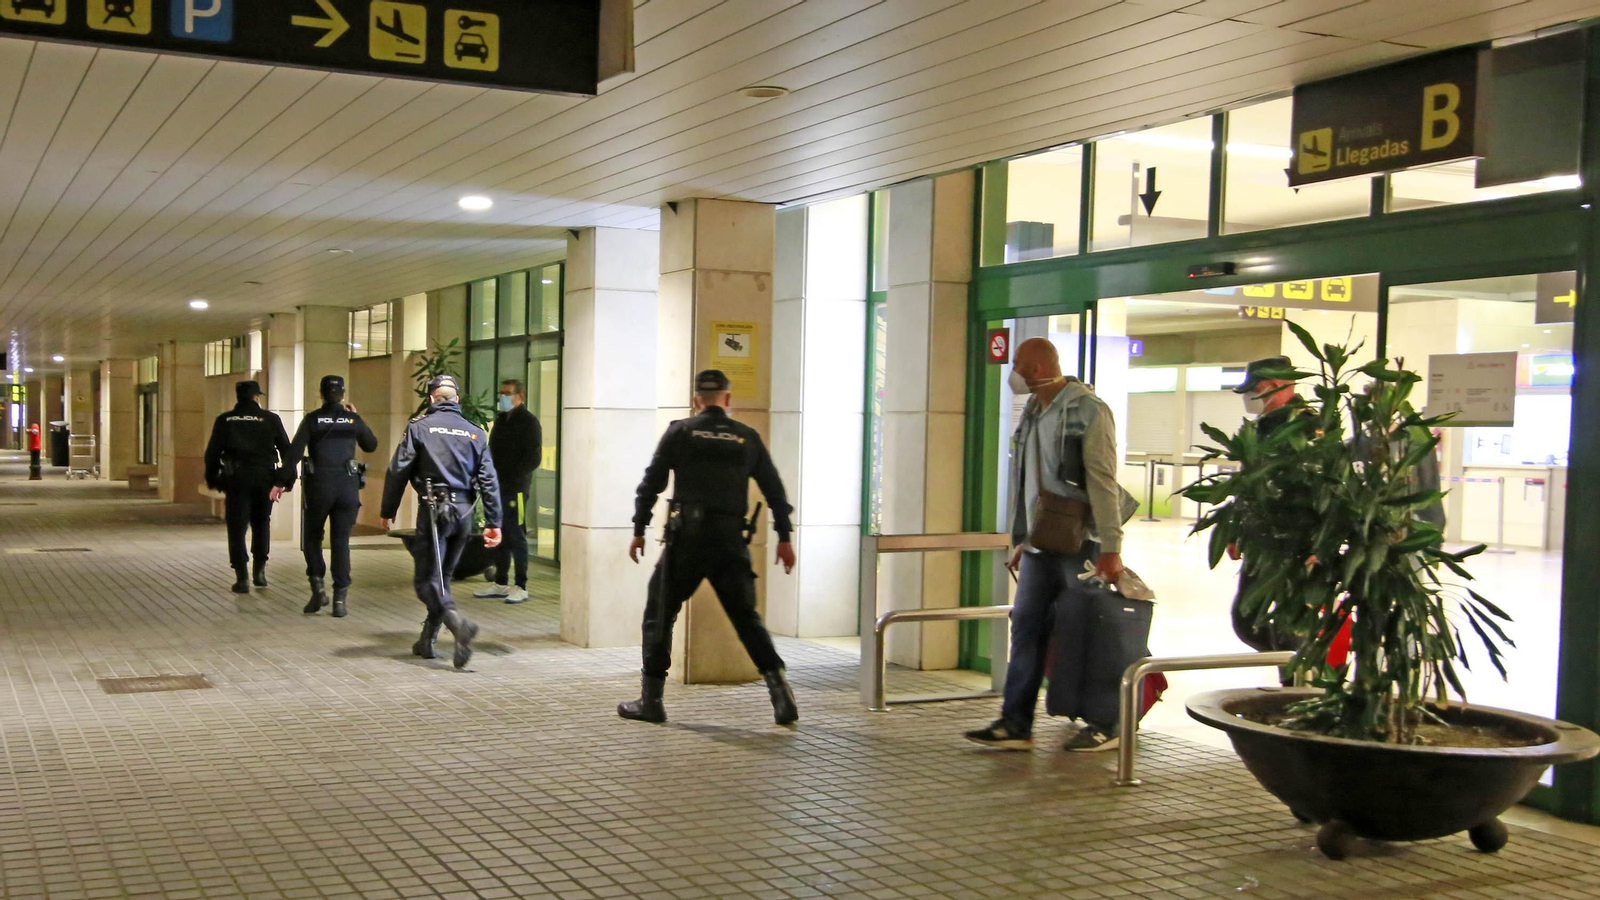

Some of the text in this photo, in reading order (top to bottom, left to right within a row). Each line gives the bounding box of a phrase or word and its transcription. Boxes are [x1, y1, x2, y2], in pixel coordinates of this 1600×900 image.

[185, 0, 222, 33] P
[1420, 82, 1460, 151] B
[1336, 139, 1410, 166] Llegadas
